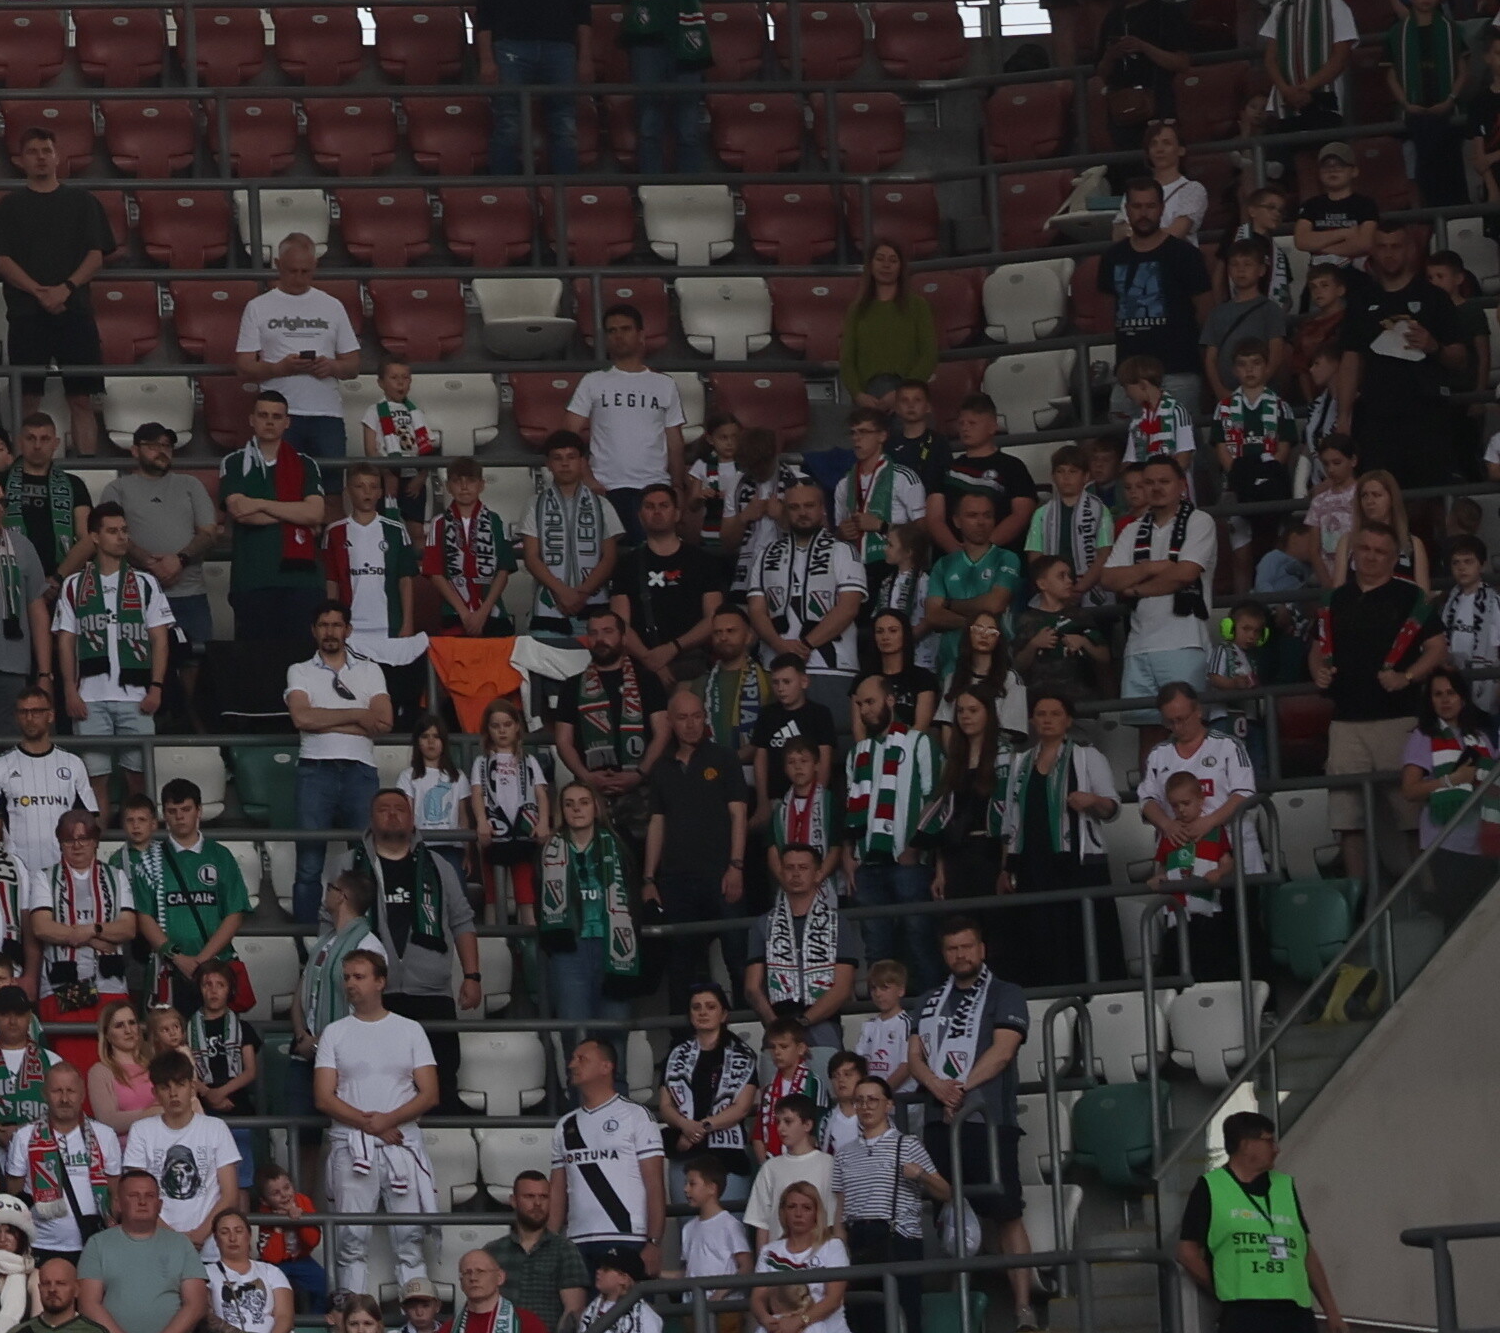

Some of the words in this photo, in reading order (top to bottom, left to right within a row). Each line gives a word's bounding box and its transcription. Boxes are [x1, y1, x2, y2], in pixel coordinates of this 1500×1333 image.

[268, 316, 328, 331] originals
[602, 393, 659, 407] LEGIA
[13, 795, 69, 808] FORTUNA
[562, 1149, 619, 1163] ORTUNA
[1250, 1260, 1284, 1273] I-83
